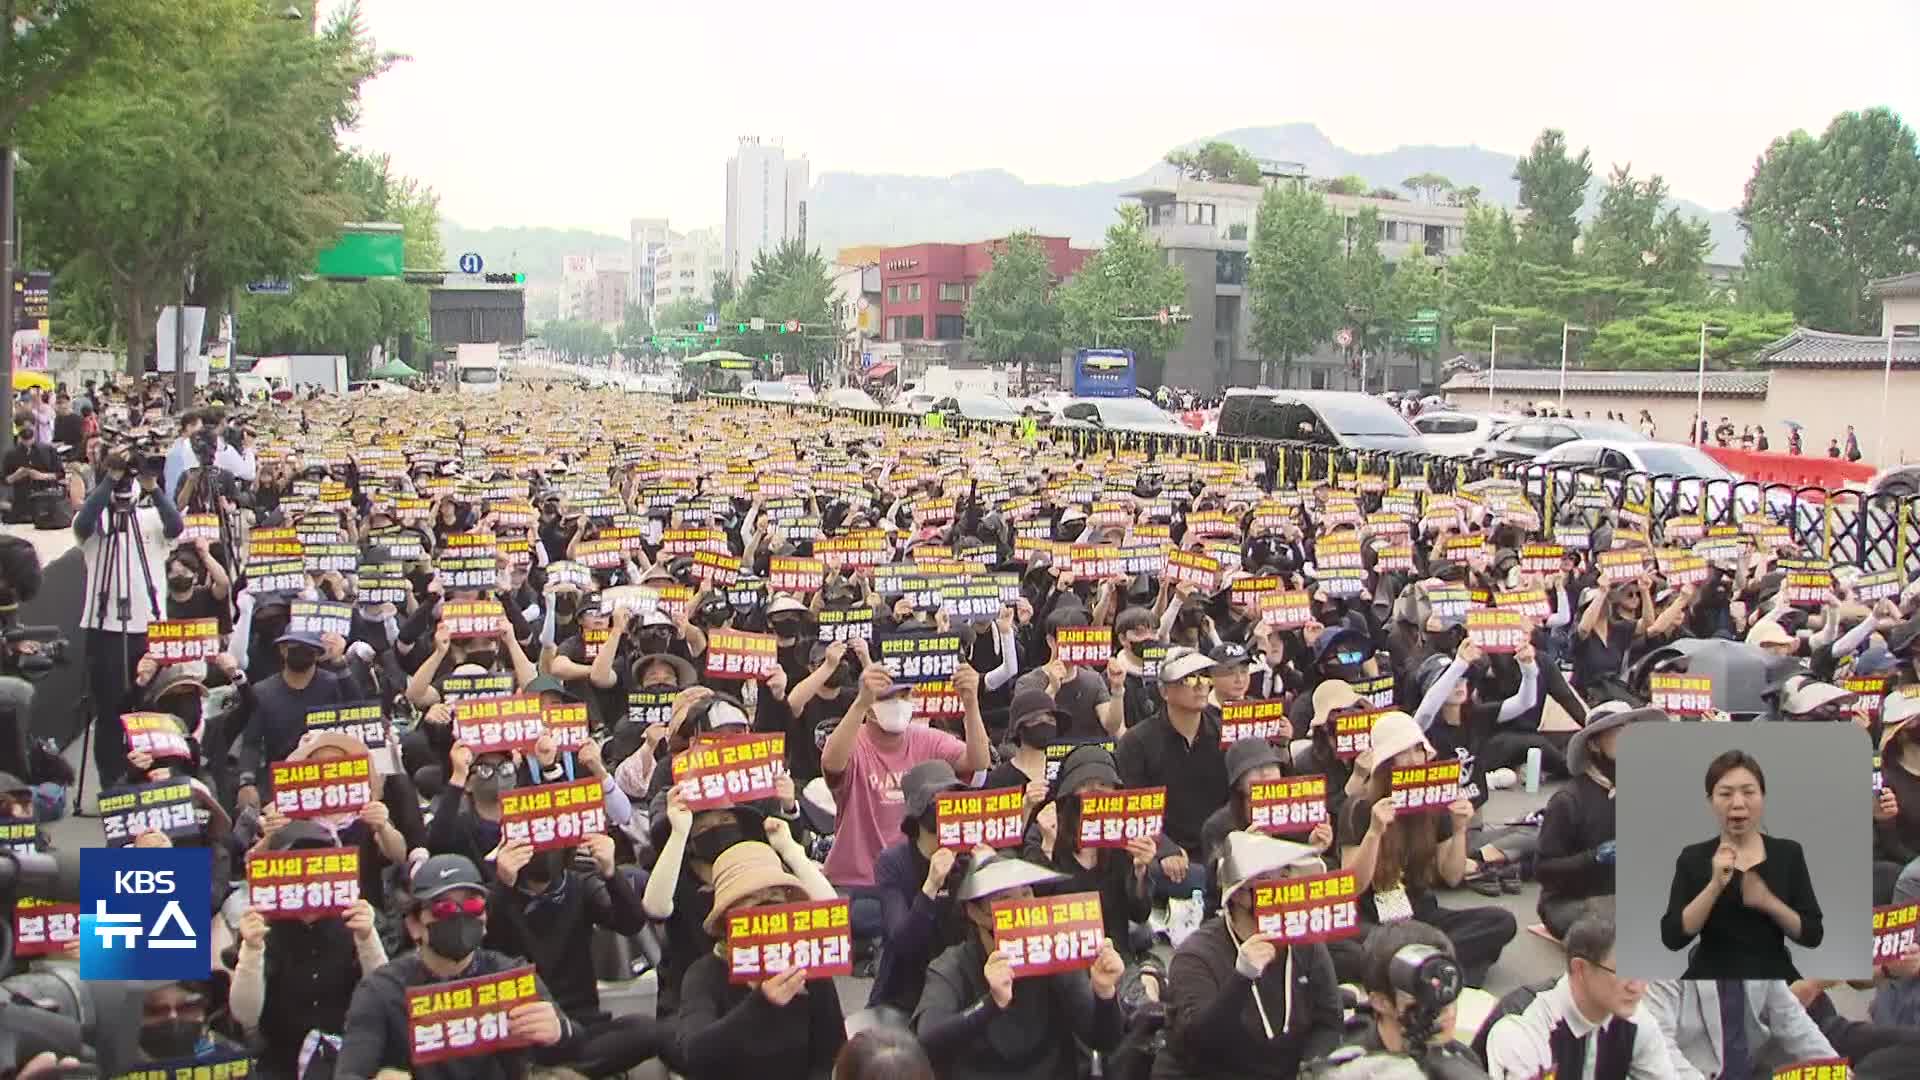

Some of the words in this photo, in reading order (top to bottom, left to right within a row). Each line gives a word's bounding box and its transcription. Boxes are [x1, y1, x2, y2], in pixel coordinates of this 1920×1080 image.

[148, 624, 181, 638] 교사의
[183, 622, 218, 636] 교육권
[149, 639, 220, 660] 보장하라
[882, 639, 915, 653] 안전한
[918, 637, 960, 652] 교육환경
[886, 655, 959, 677] 조성하라
[456, 701, 498, 720] 교사의
[501, 697, 540, 716] 교육권
[1222, 704, 1253, 720] 교사의
[1255, 702, 1283, 717] 교육권
[460, 717, 545, 746] 보장하라
[1221, 719, 1281, 743] 보장하라
[1336, 713, 1368, 732] 교사의
[1337, 733, 1371, 753] 보장
[274, 765, 320, 785] 교사의
[323, 759, 369, 779] 교육권
[674, 751, 720, 774] 교사의
[723, 744, 769, 765] 교육권
[682, 766, 775, 801] 보장하라
[1392, 770, 1426, 785] 교사의
[1427, 765, 1460, 780] 교육권
[99, 794, 136, 813] 안전한
[141, 784, 191, 804] 교육환경
[276, 781, 371, 813] 보장하라
[503, 791, 552, 815] 교사의
[556, 784, 603, 806] 교육권
[1251, 784, 1287, 801] 교사의
[1291, 779, 1326, 797] 교육권
[1392, 783, 1458, 808] 보장하라
[938, 800, 982, 817] 교사의
[985, 793, 1022, 813] 교육권
[1083, 798, 1123, 815] 교사의
[1127, 793, 1165, 811] 교육권
[1252, 801, 1327, 826] 보장하라
[103, 802, 195, 839] 조성하라
[506, 810, 607, 845] 보장하라
[940, 815, 1023, 846] 보장하라
[1081, 816, 1163, 842] 보장하라
[251, 857, 302, 879] 교사의
[306, 853, 358, 876] 교육권
[251, 874, 360, 911] 보장하라
[1256, 882, 1305, 907] 교사의
[1310, 876, 1355, 898] 교육권
[731, 912, 788, 938] 교사의
[793, 905, 848, 932] 교육권
[996, 906, 1048, 931] 교사의
[1053, 899, 1100, 922] 교육권
[1257, 901, 1357, 940] 보장하라
[732, 935, 850, 975] 보장하라
[999, 927, 1102, 968] 보장하라
[411, 988, 473, 1019] 교사의
[478, 974, 537, 1005] 교육권
[414, 1011, 509, 1053] 보장하
